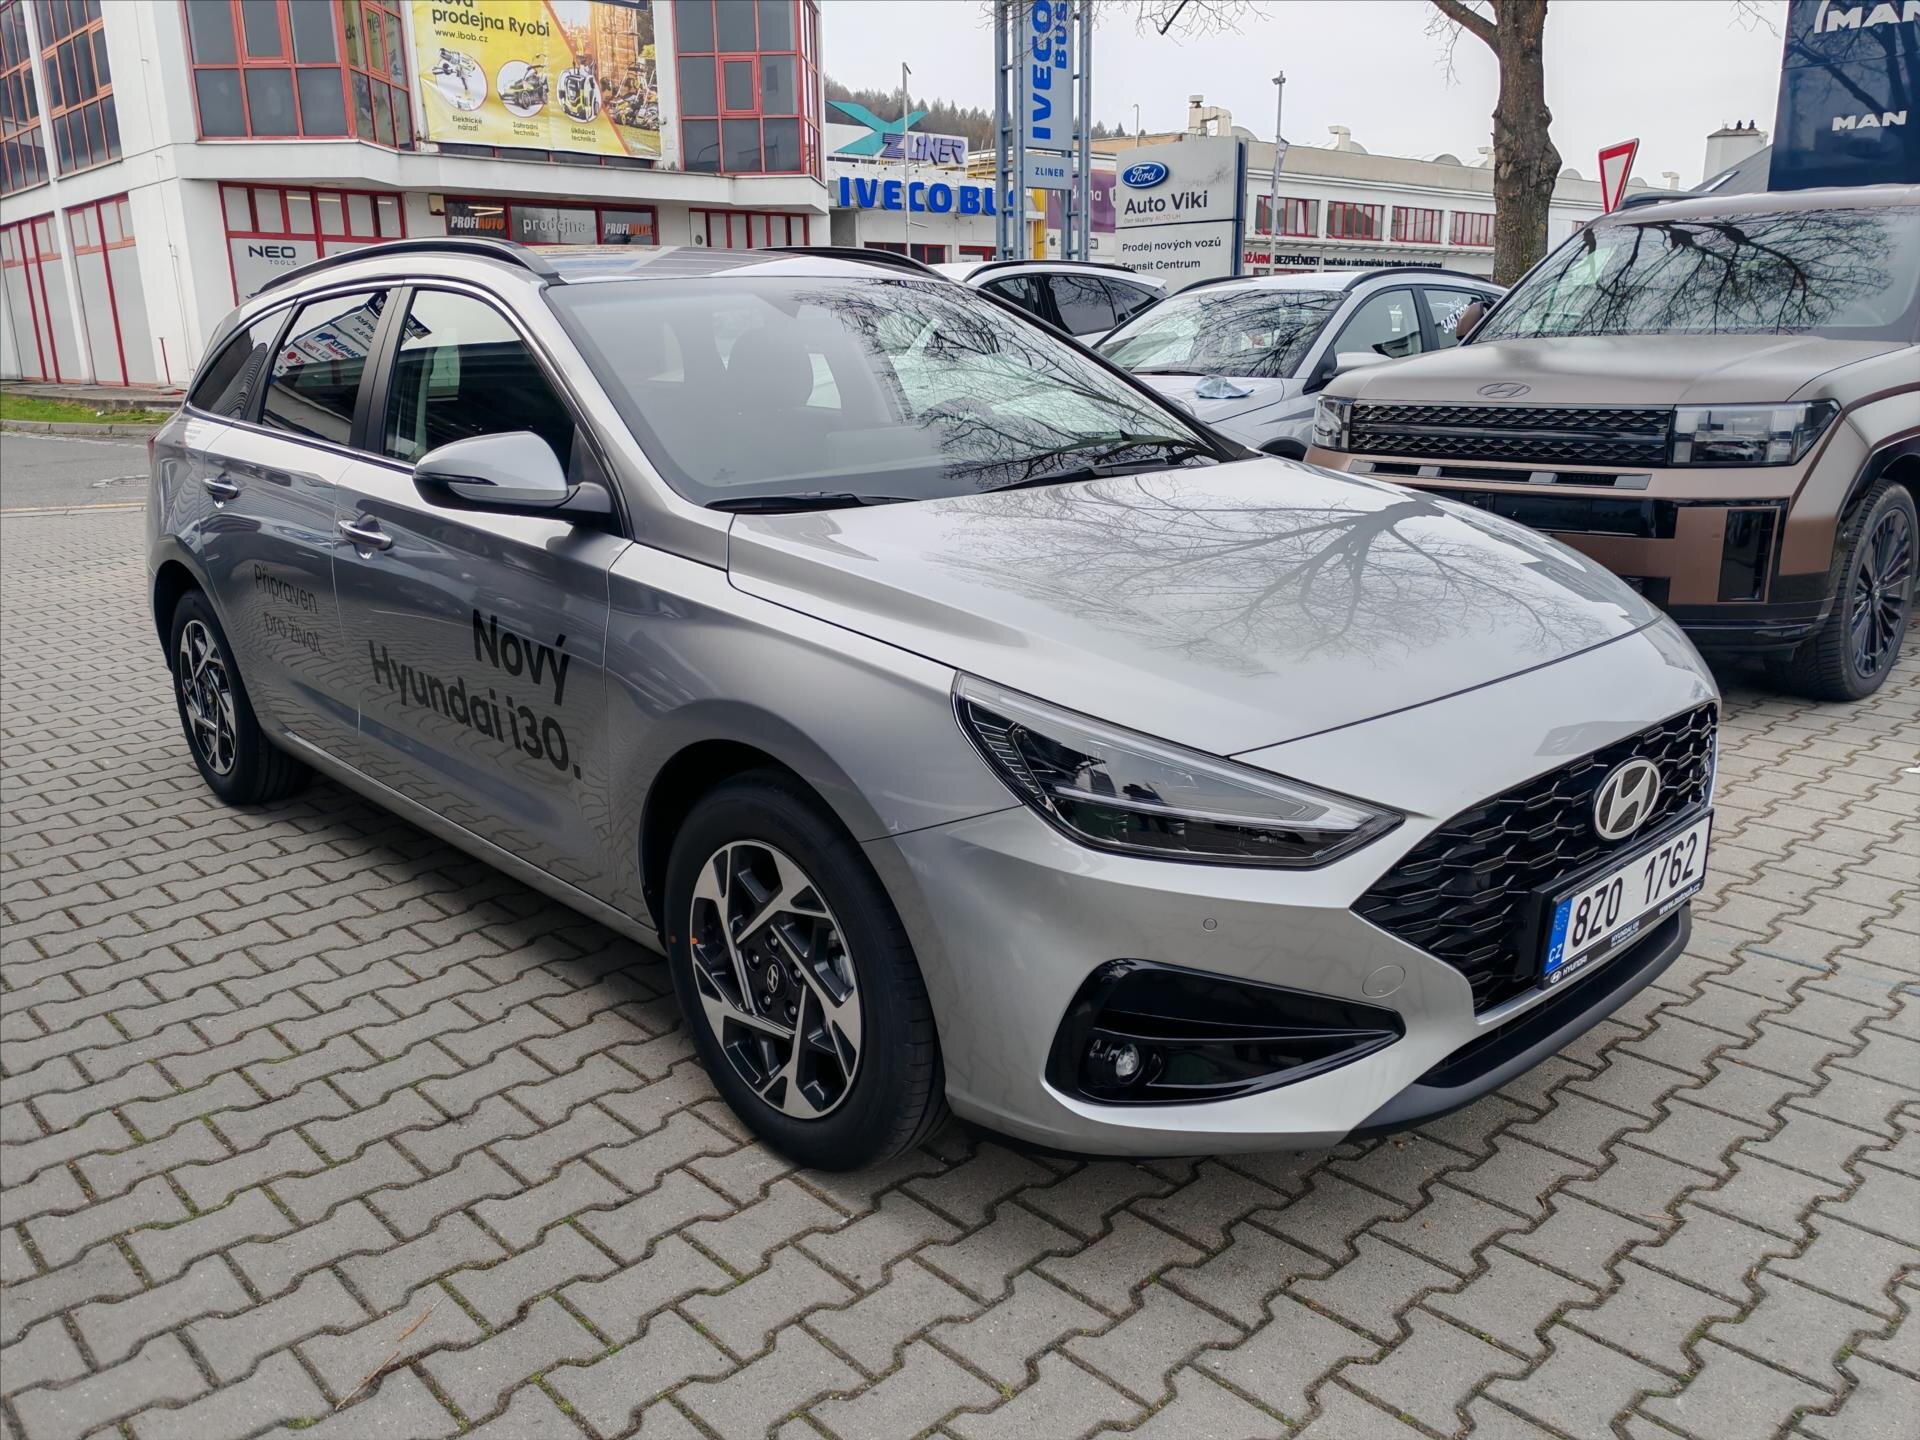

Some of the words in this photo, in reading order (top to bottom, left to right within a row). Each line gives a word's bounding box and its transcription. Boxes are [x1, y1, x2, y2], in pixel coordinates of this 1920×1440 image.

[432, 9, 504, 31] prodejna
[509, 17, 550, 37] Ryobi
[1055, 1, 1068, 69] BUS
[1032, 0, 1052, 140] IVECO
[1832, 110, 1907, 131] MAN
[1130, 166, 1157, 183] Ford
[838, 176, 953, 213] IVECO
[1124, 197, 1167, 215] Auto
[1171, 190, 1208, 210] Viki
[523, 217, 587, 236] prodejna
[248, 245, 296, 258] NEO
[1122, 243, 1152, 253] Prodej
[1154, 240, 1192, 251] nových
[1122, 262, 1154, 272] Transit
[1156, 259, 1201, 270] Centrum
[1275, 254, 1321, 266] BEZPEČNOST
[254, 563, 318, 614] Připraven
[263, 611, 287, 637] pro
[472, 608, 571, 706] Nový
[368, 640, 505, 744] Hyundai
[507, 695, 582, 780] i30.
[1643, 832, 1697, 905] 1762
[1549, 943, 1563, 963] CZ
